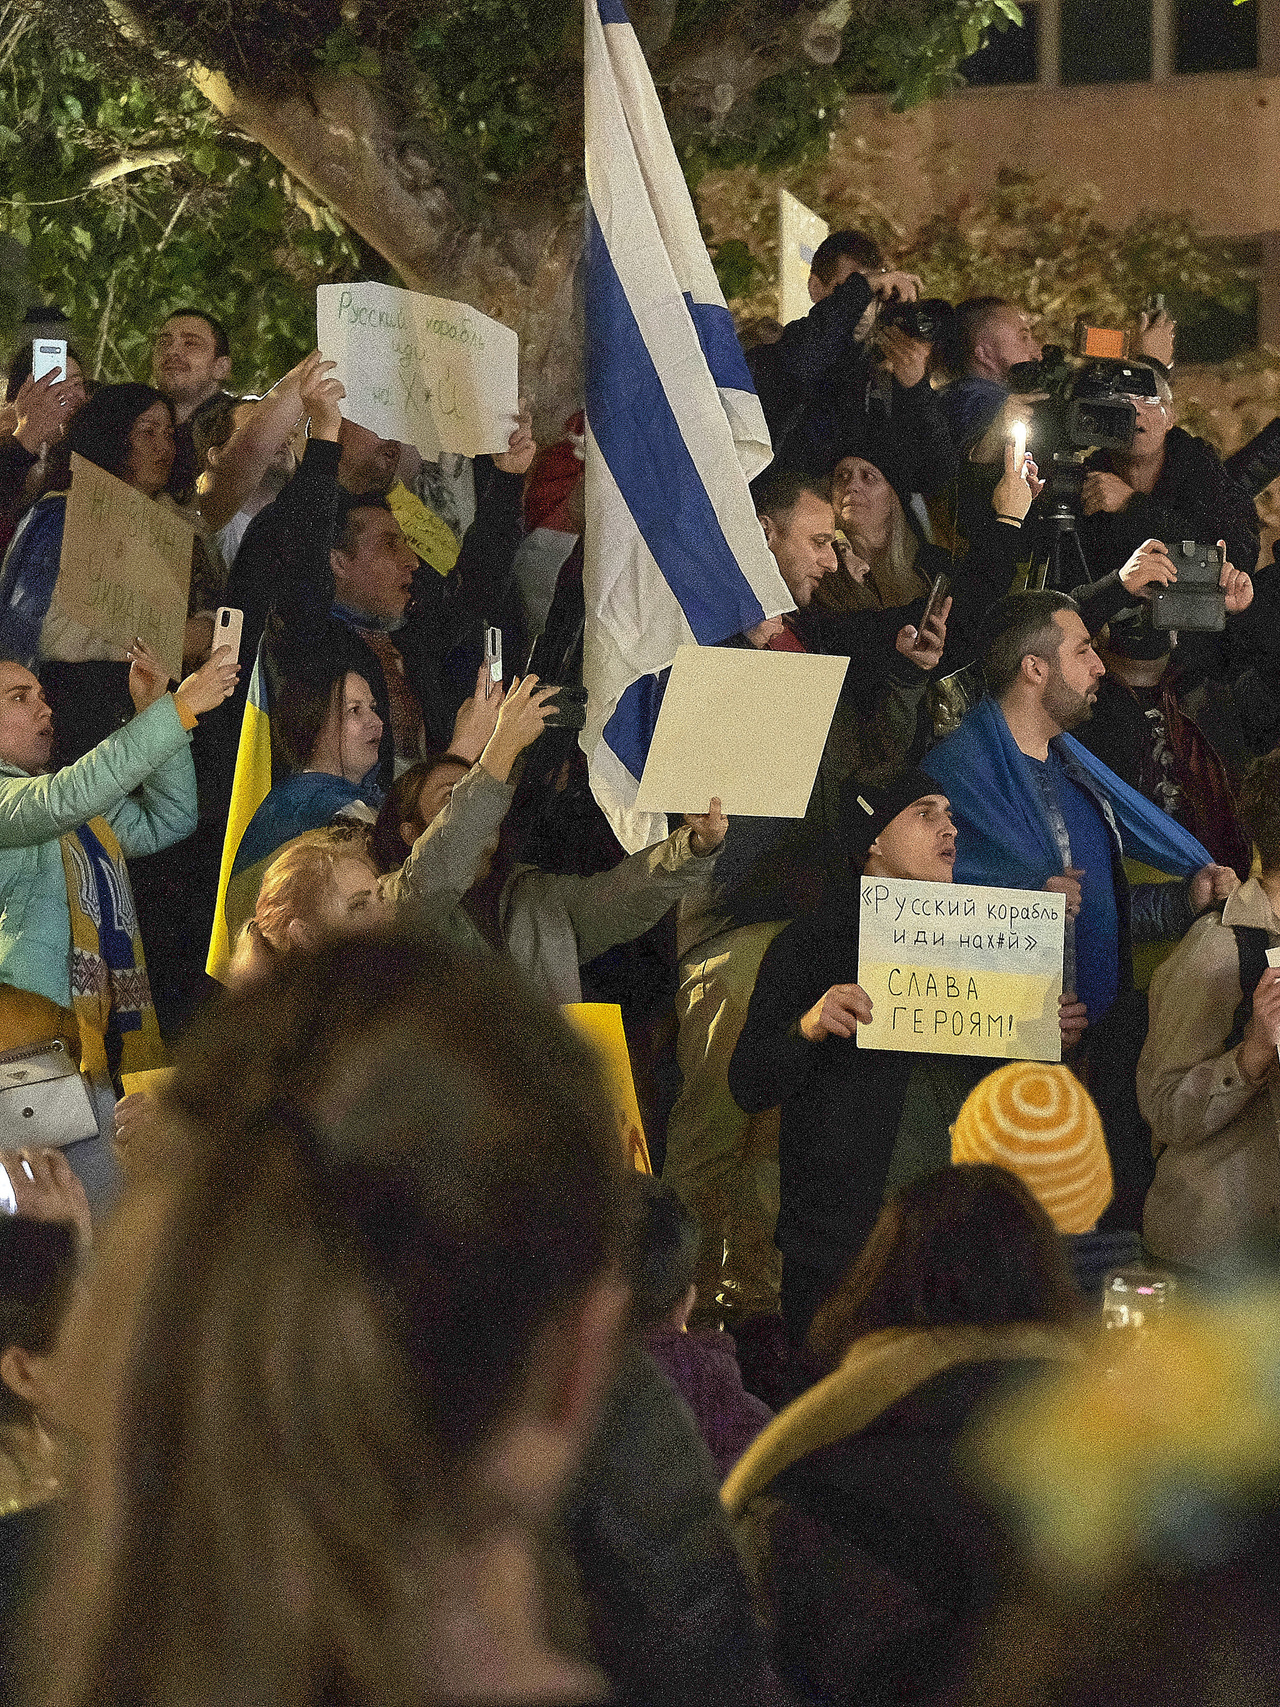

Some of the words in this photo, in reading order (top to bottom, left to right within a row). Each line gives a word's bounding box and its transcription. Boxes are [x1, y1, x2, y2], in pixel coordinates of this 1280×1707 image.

[337, 291, 407, 330] Русский
[861, 884, 976, 922] «Русский
[987, 902, 1060, 930] корабль
[887, 968, 979, 1001] СЛАВА
[892, 1006, 1014, 1038] ГЕРОЯМ!
